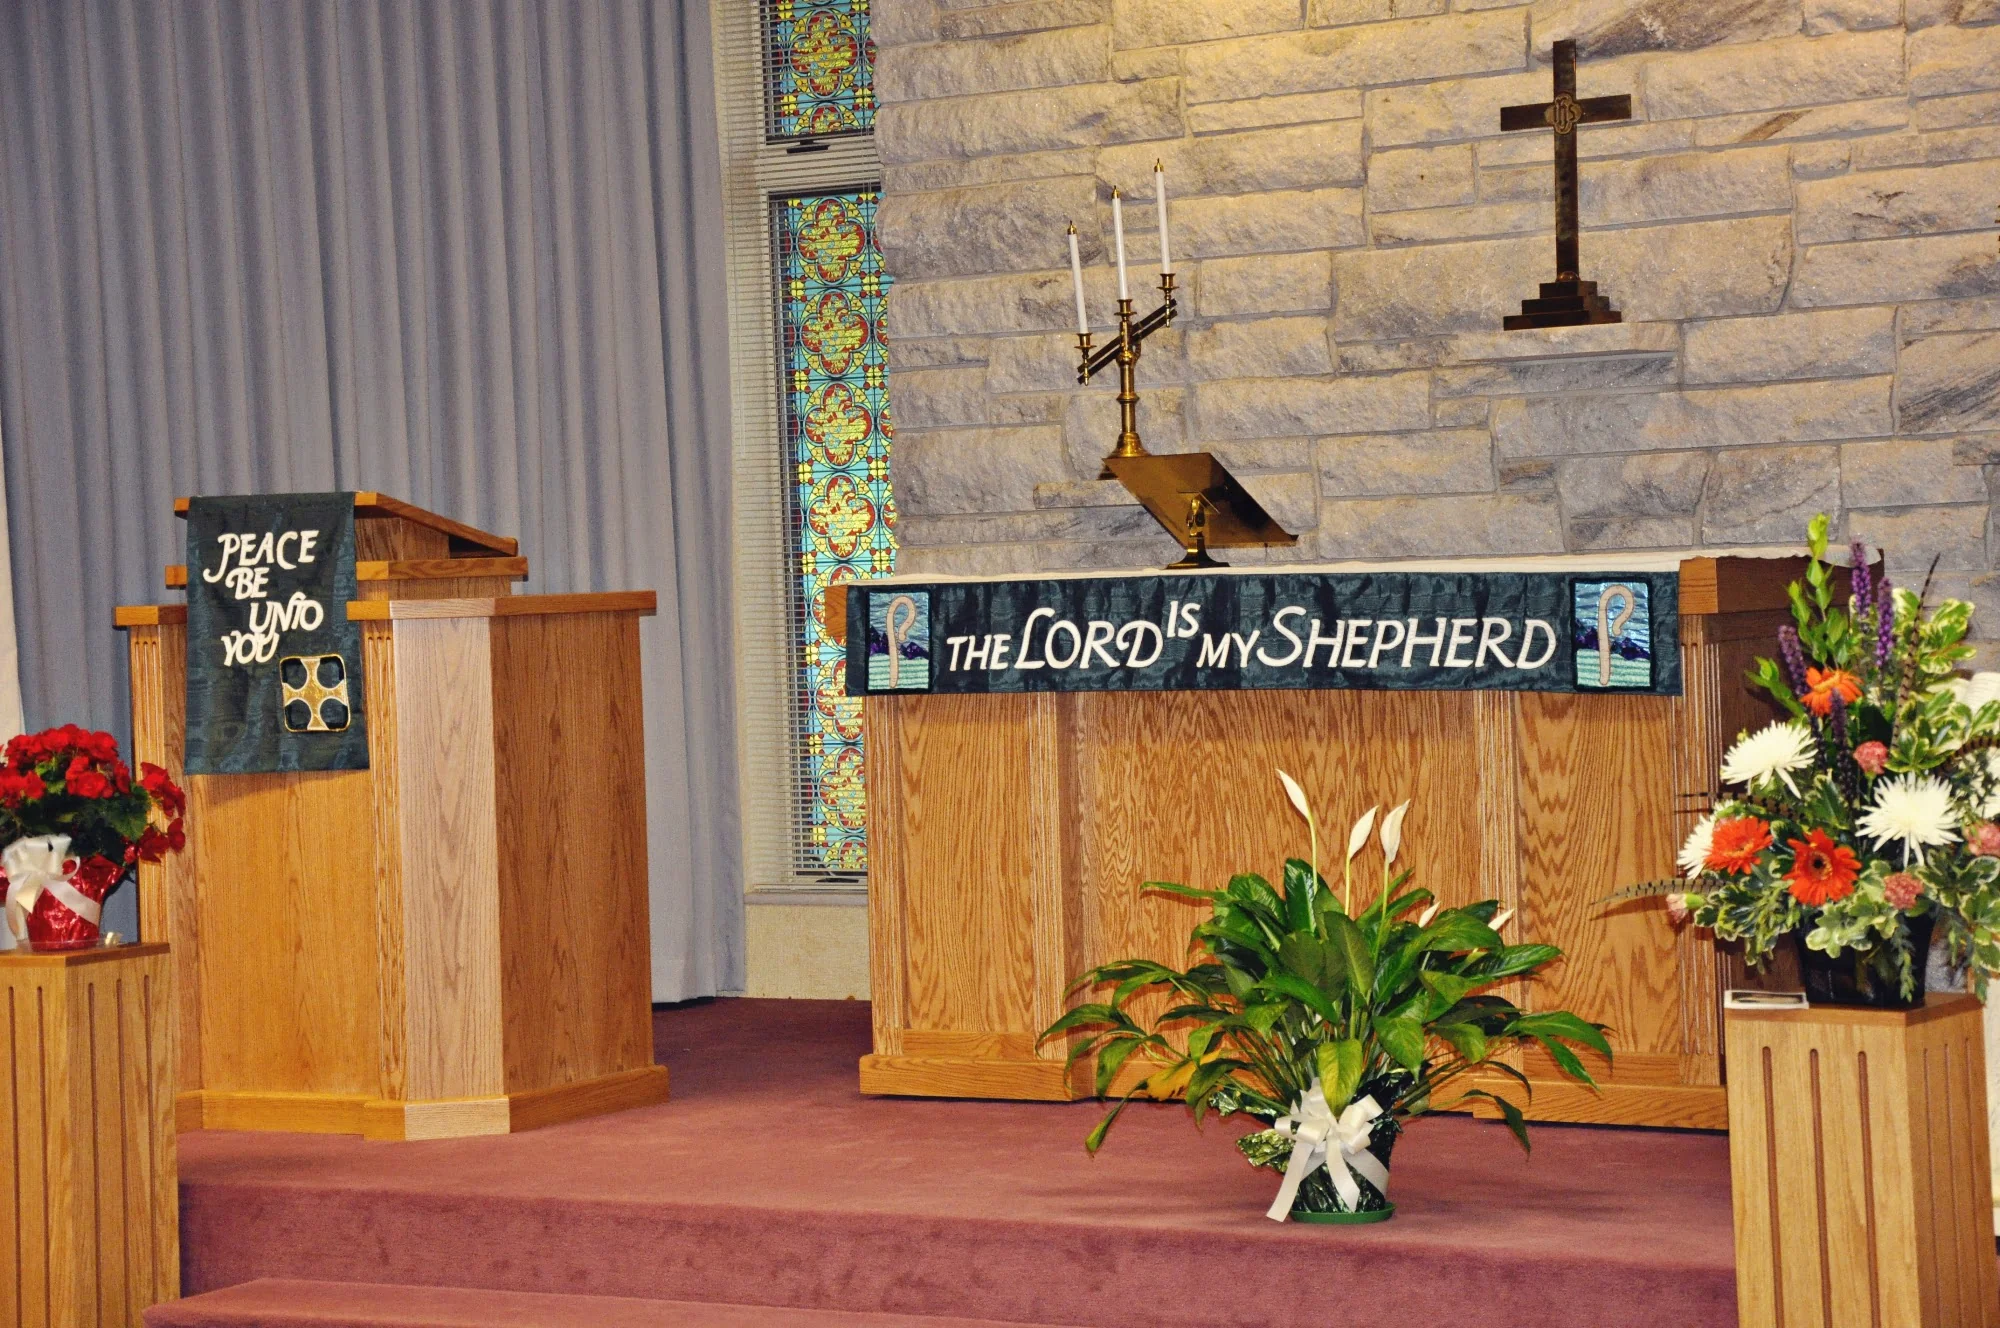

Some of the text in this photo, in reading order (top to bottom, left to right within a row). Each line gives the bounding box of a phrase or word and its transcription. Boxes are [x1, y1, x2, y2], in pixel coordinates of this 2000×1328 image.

[203, 530, 319, 583] PEACE
[225, 567, 270, 600] BE
[250, 592, 324, 637] UNTO
[947, 600, 1557, 671] THE LORD IS MY SHEPHERD
[221, 630, 279, 667] YOU
